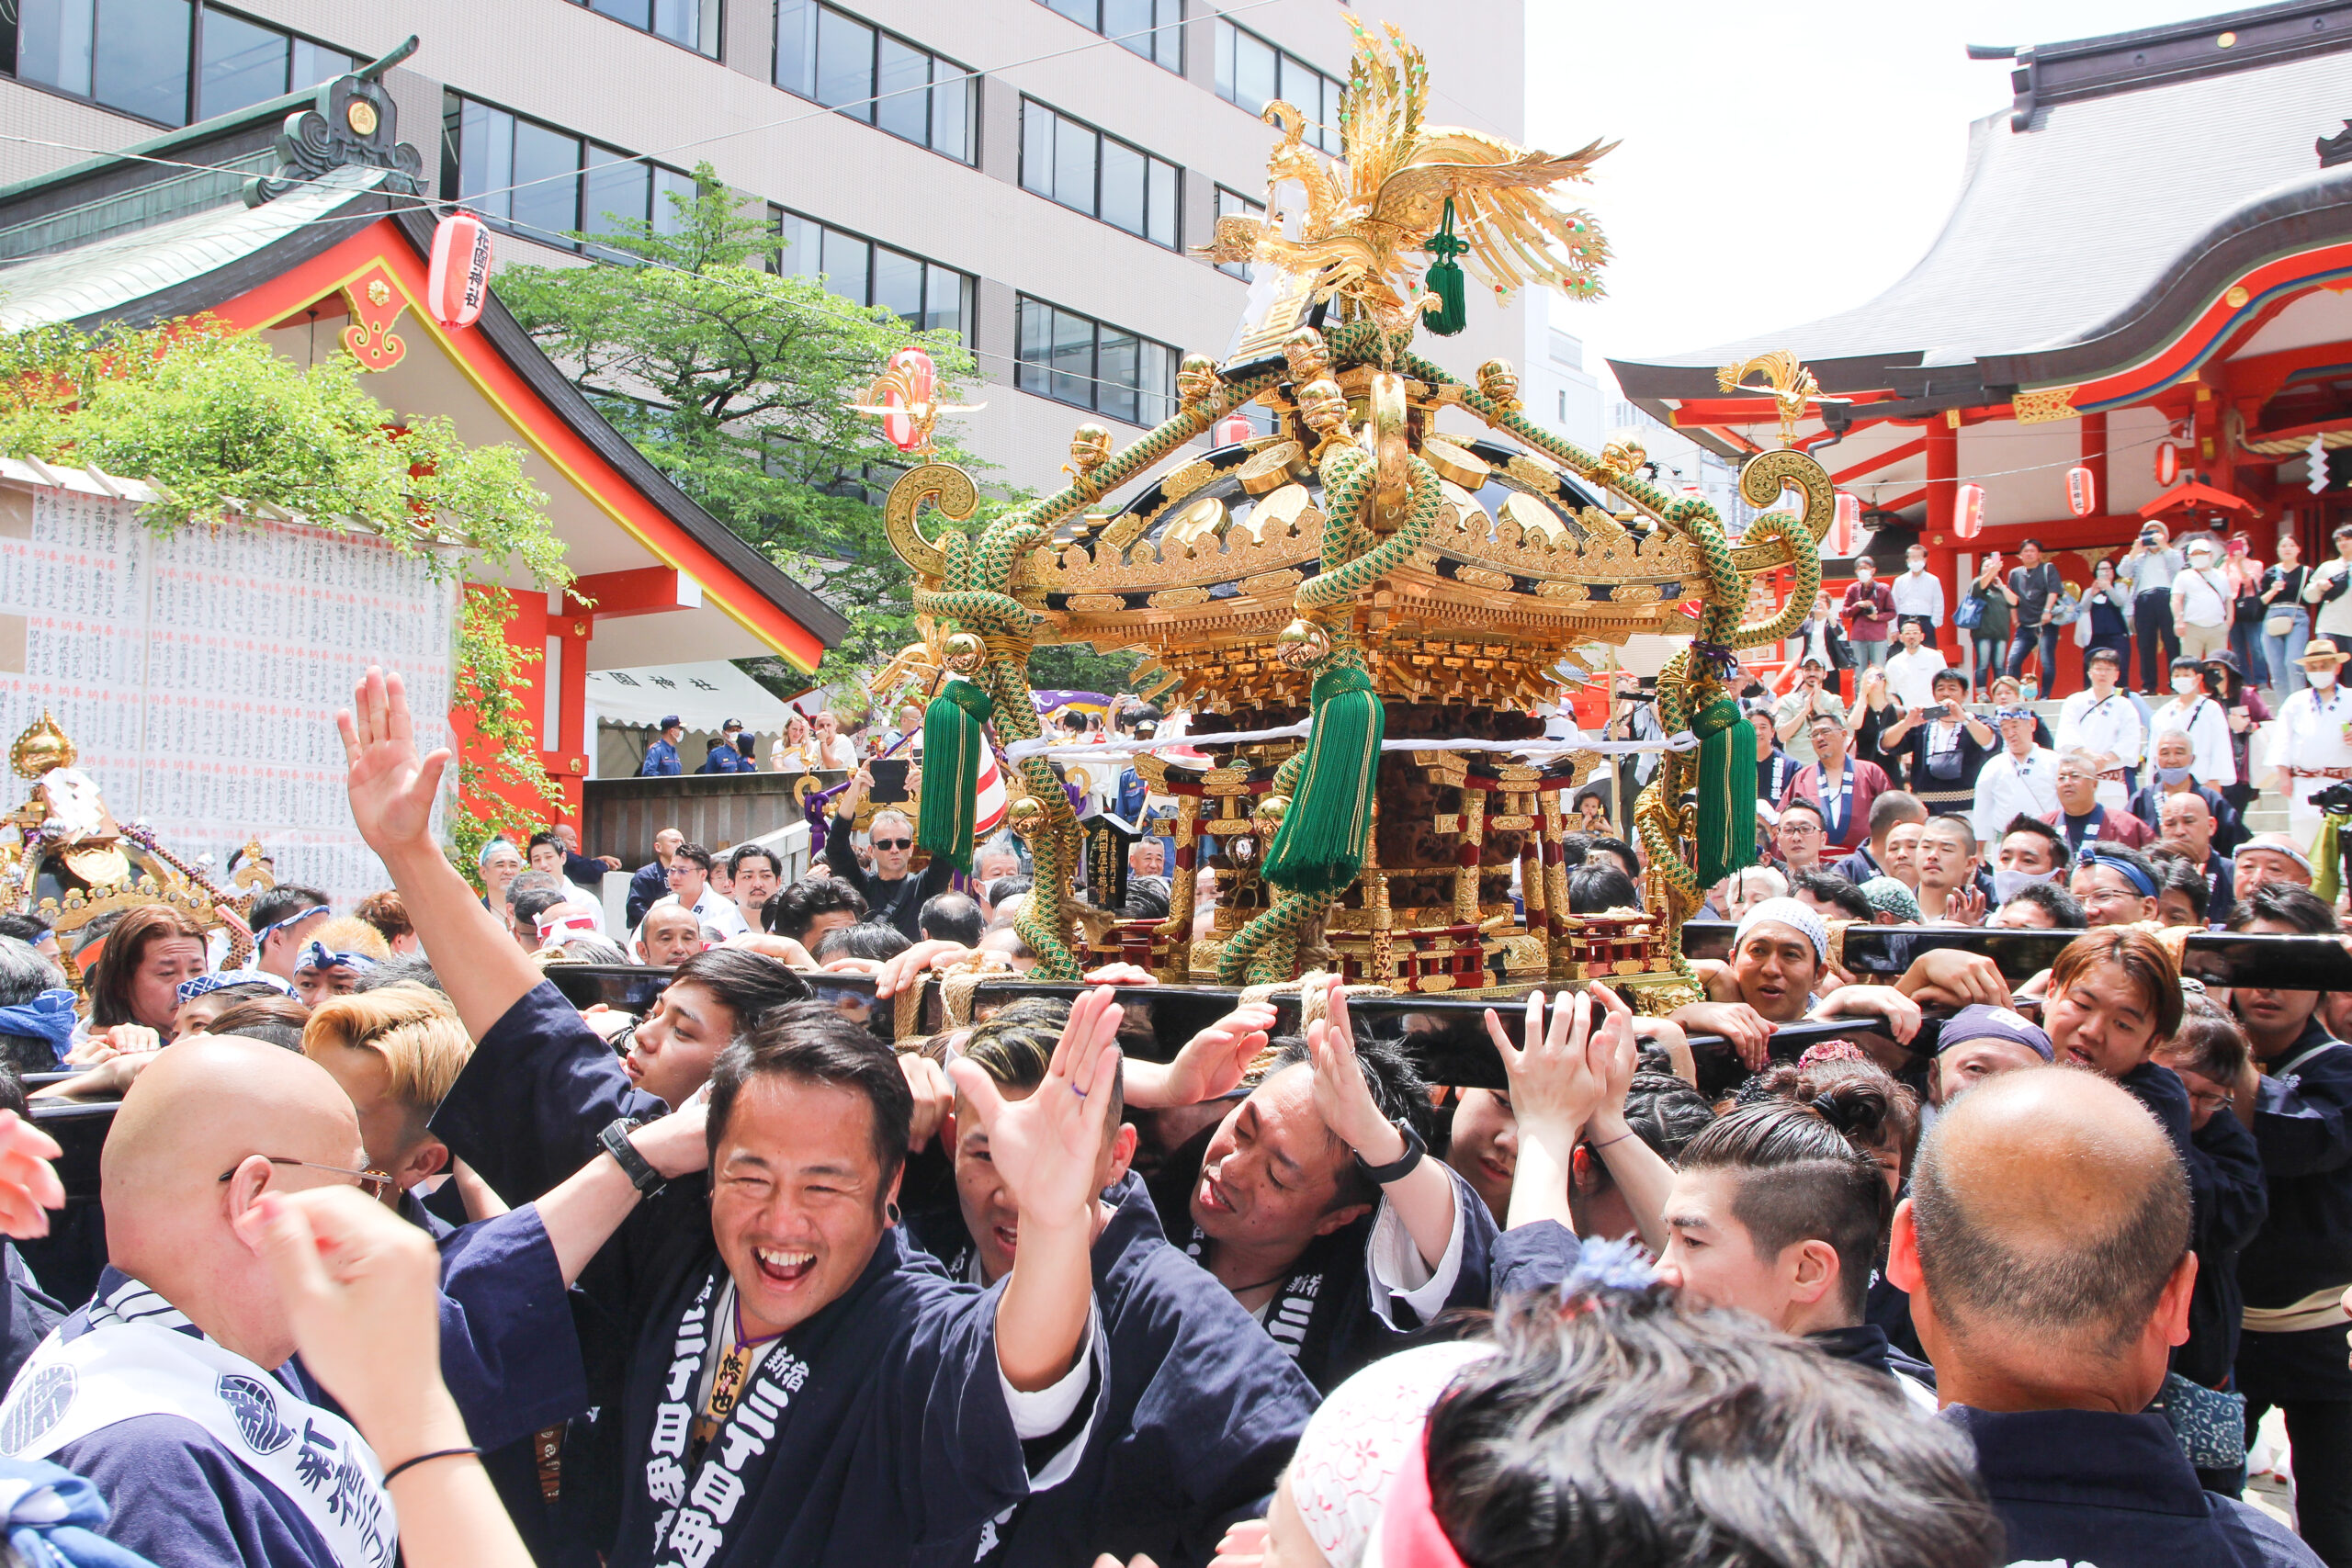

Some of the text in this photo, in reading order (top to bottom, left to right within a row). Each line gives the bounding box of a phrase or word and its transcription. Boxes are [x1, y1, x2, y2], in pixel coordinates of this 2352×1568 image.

[464, 228, 490, 309] 花園神社
[2074, 472, 2083, 511] 花園神社
[586, 671, 720, 691] 園神社
[764, 1345, 809, 1393] 新宿
